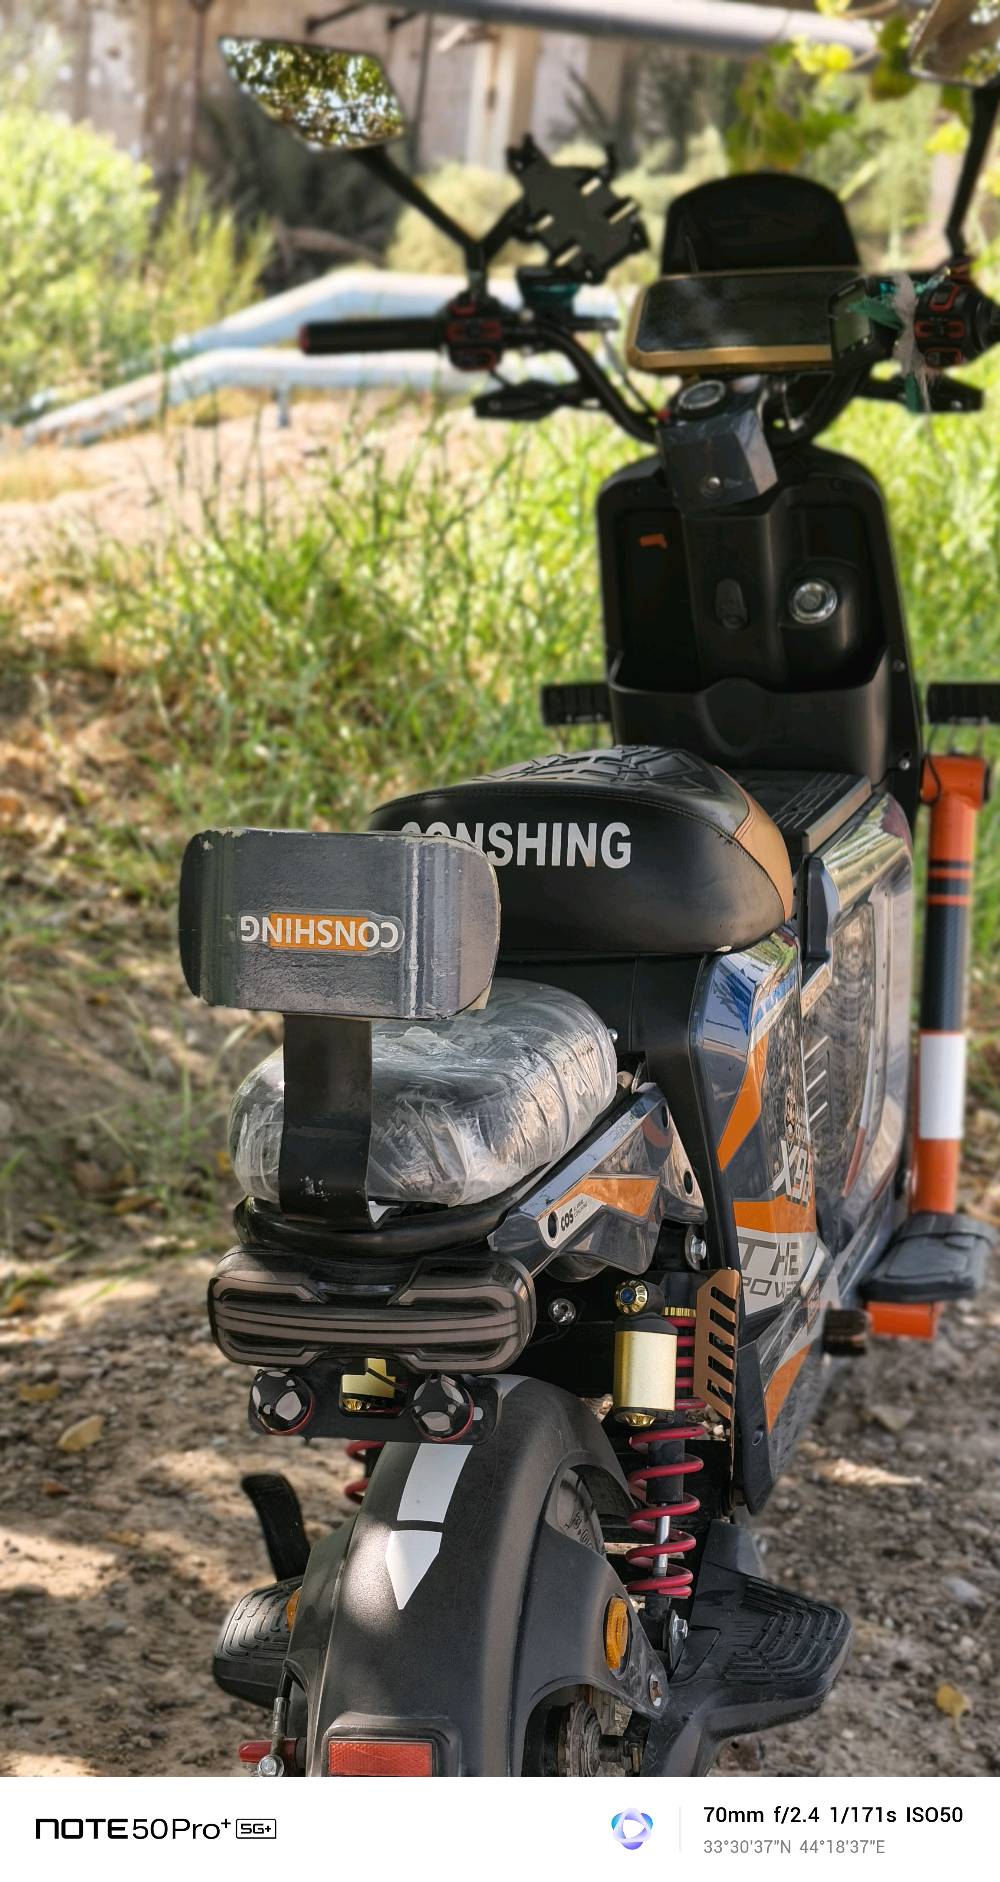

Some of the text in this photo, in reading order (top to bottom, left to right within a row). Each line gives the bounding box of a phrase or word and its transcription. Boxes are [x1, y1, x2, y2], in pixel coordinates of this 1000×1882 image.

[400, 821, 632, 868] NSHING
[240, 915, 399, 948] CONSHING
[738, 1235, 799, 1275] THE
